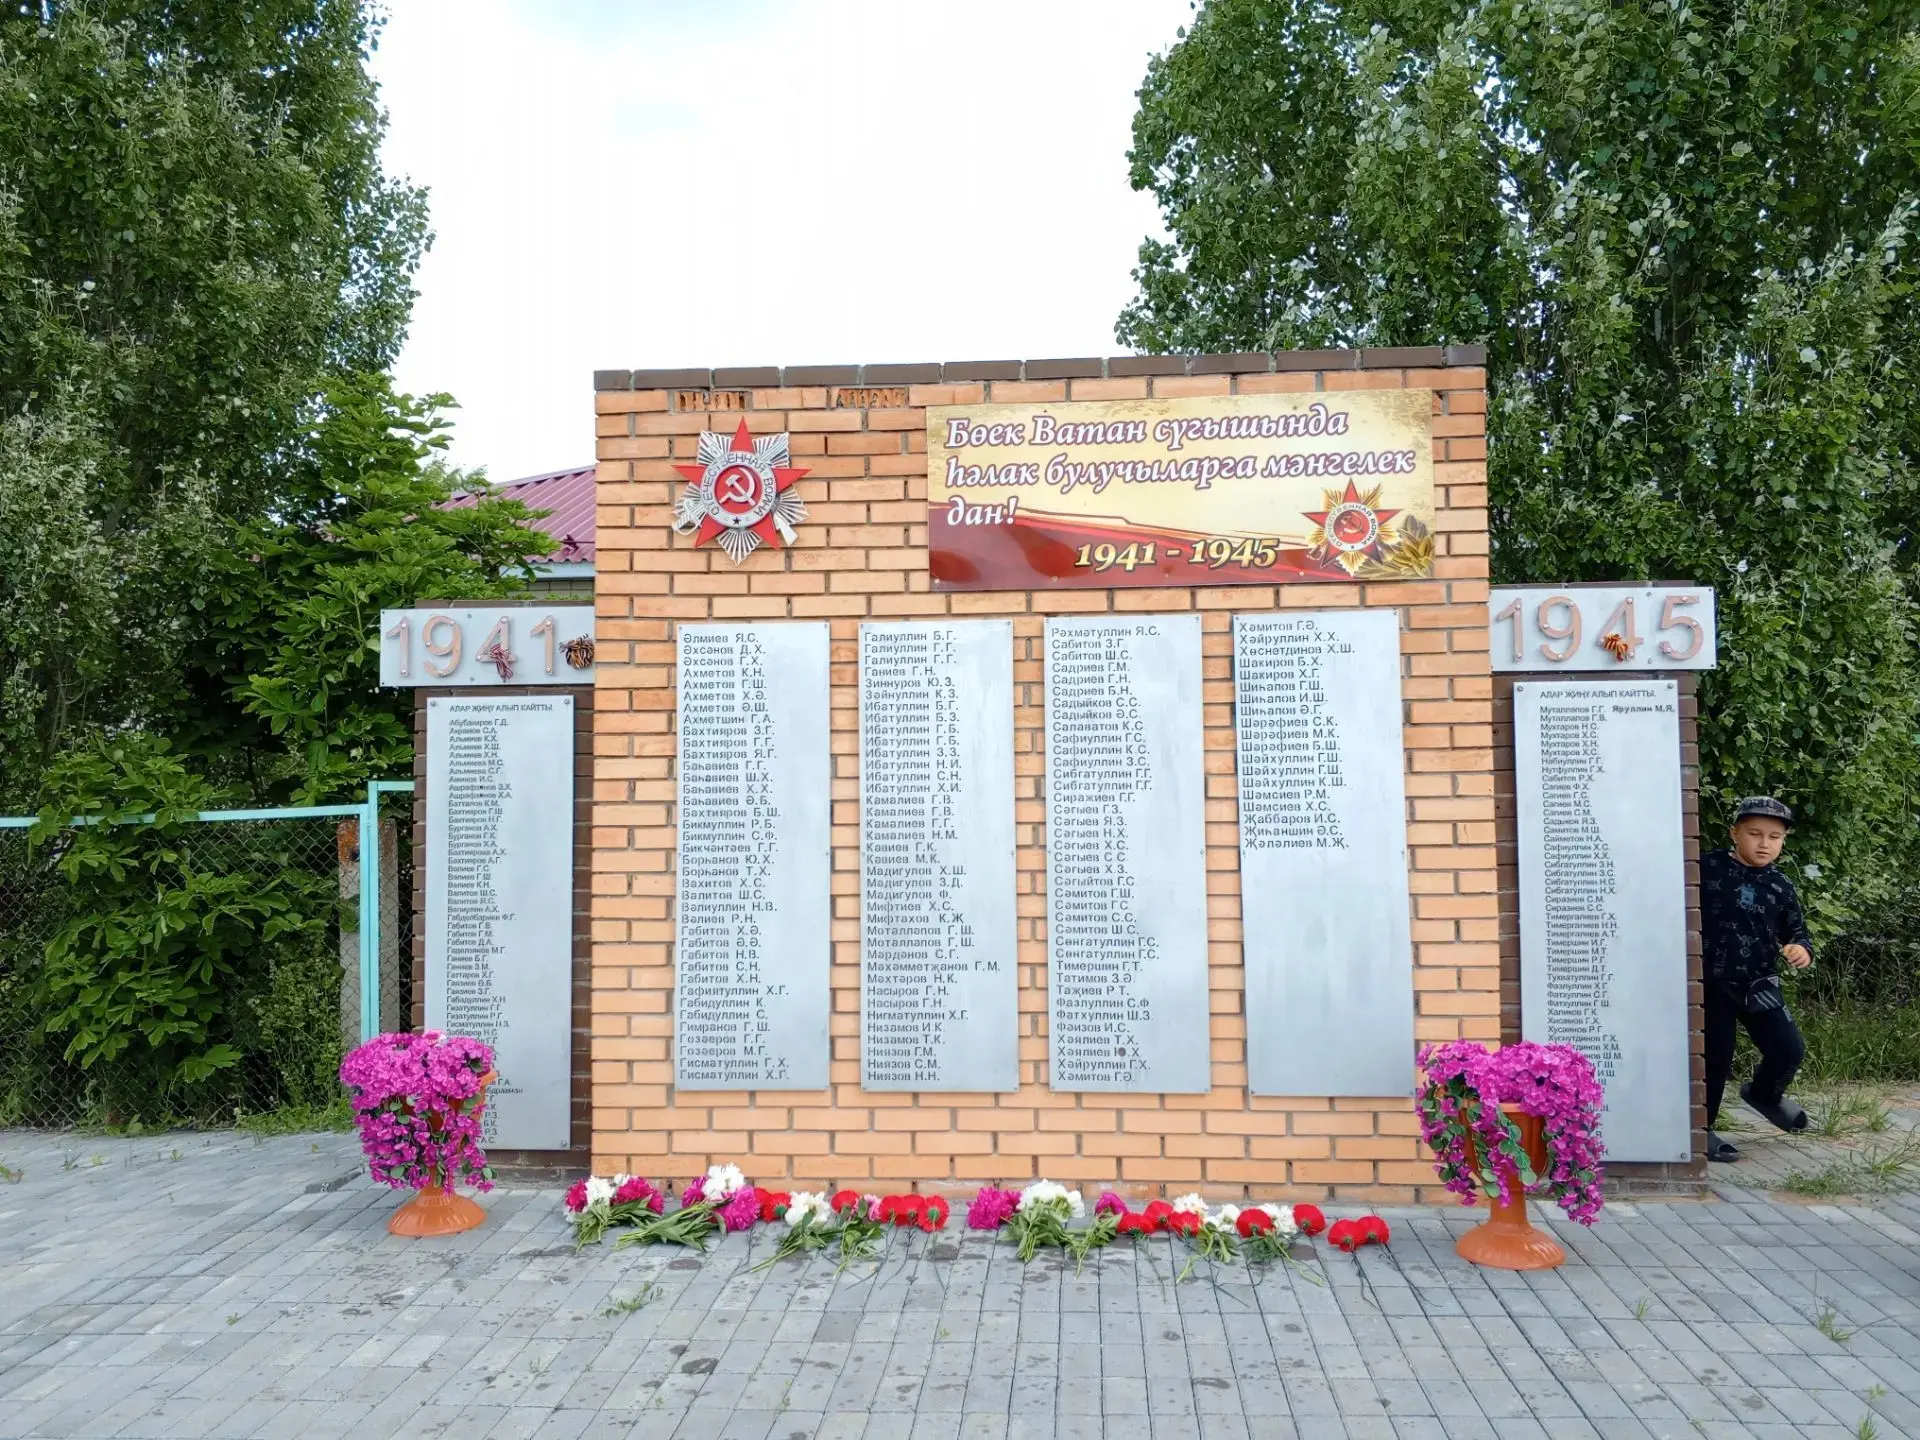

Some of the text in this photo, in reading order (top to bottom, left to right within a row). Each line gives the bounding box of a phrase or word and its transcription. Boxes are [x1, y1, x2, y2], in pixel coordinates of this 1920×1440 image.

[945, 417, 1025, 448] Бөек
[1030, 415, 1147, 446] Ватан
[945, 456, 1039, 488] һәлак
[1044, 453, 1257, 493] булучыларга
[947, 496, 1017, 526] дан!
[1073, 541, 1156, 573] 1941
[1188, 537, 1280, 570] 1945
[386, 614, 556, 678] 1941
[1496, 594, 1705, 662] 1945
[1591, 690, 1617, 698] АЛЫП
